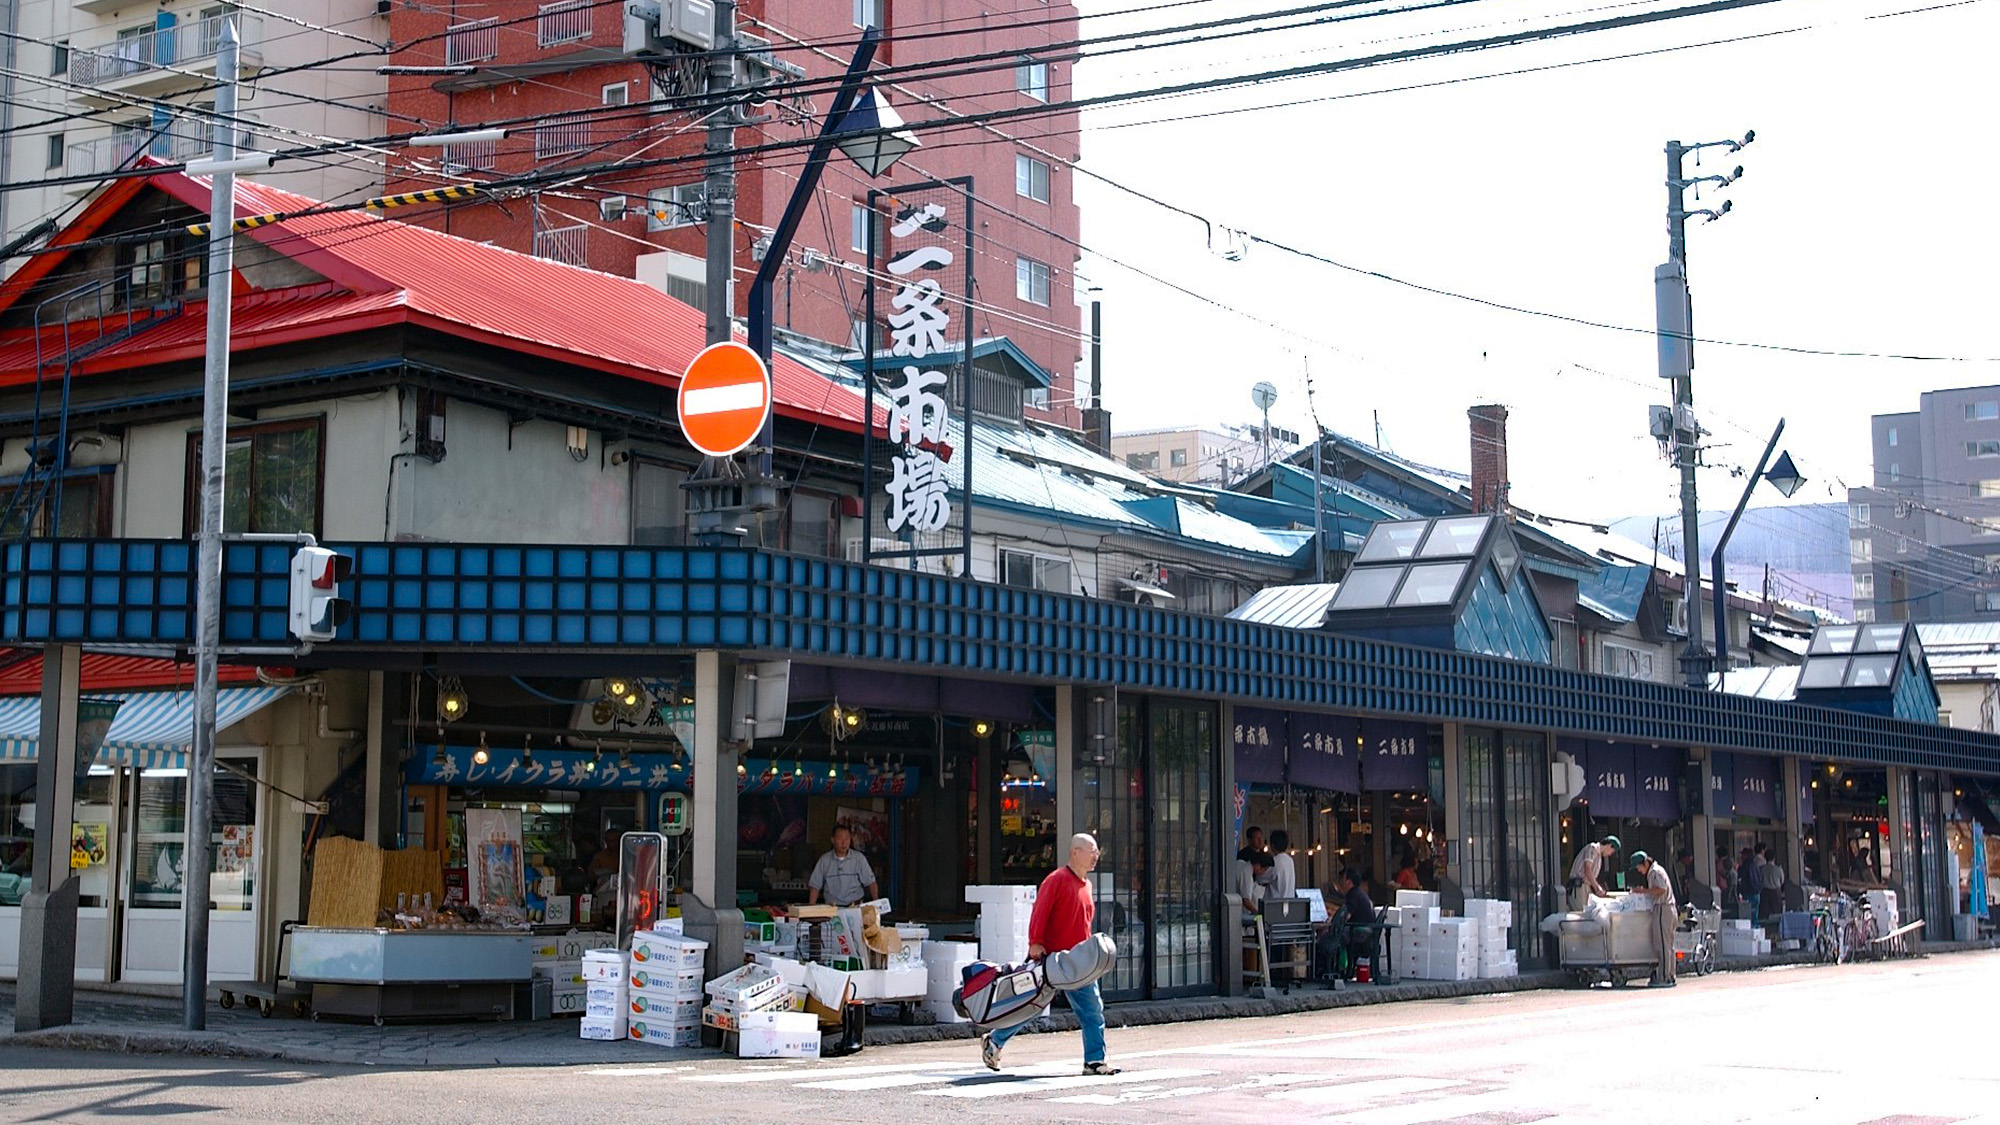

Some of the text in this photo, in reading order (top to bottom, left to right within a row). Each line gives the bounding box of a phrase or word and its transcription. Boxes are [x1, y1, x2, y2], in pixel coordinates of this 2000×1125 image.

[886, 201, 953, 533] 二条市場
[663, 807, 681, 815] JCB
